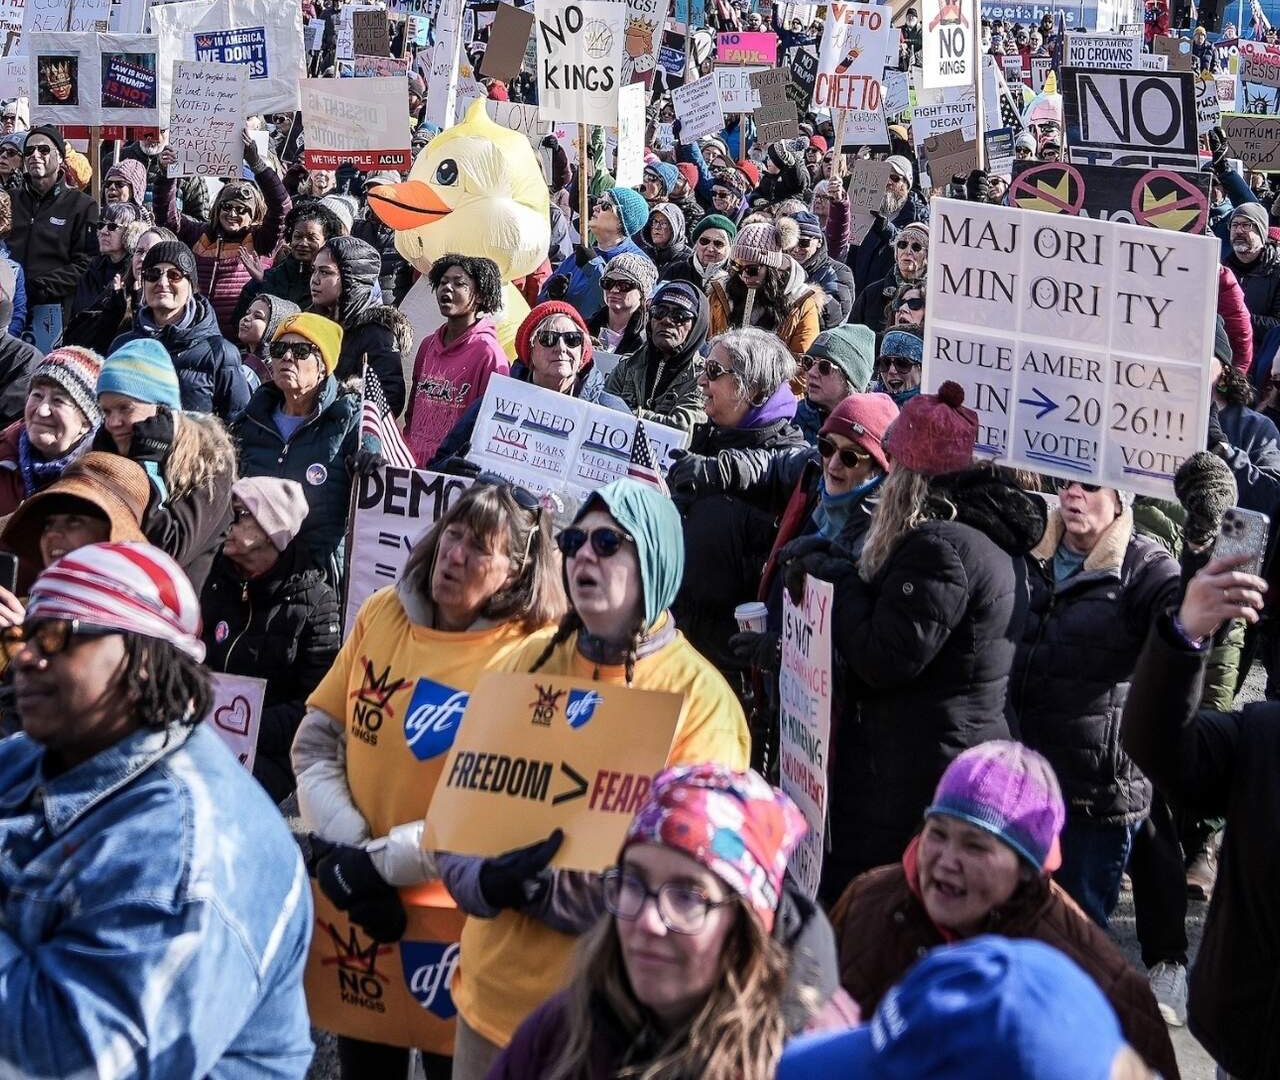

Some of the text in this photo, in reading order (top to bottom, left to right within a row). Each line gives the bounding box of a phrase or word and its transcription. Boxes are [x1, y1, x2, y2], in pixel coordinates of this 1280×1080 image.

[831, 3, 882, 30] VETO
[215, 32, 264, 45] IN AMERICA,
[540, 6, 583, 54] NO
[721, 35, 740, 45] NO
[940, 29, 965, 58] NO
[197, 45, 264, 61] WE DON'T
[802, 54, 814, 67] NO
[1071, 48, 1132, 61] NO CROWNS
[111, 63, 154, 82] LAW KING
[544, 60, 614, 91] KINGS
[794, 65, 814, 84] TRUMP
[939, 62, 965, 75] KINGS
[1244, 61, 1280, 79] RESIST
[116, 74, 145, 90] TRUMP
[815, 72, 881, 110] CHEETO
[122, 85, 152, 102] NOT
[176, 99, 210, 110] VOTED
[914, 102, 977, 118] FIGHT TRUTH
[1078, 73, 1183, 146] NO
[930, 117, 964, 128] DECAY
[177, 127, 233, 139] FASCIST
[1228, 128, 1280, 139] UNTRUMP
[178, 139, 234, 151] RAPIST
[186, 151, 230, 163] LYING
[338, 154, 404, 165] PEOPLE. ACLU
[1234, 153, 1273, 162] WORLD
[183, 163, 238, 176] LOSER
[934, 336, 1012, 371] RULE
[975, 383, 1009, 415] IN
[495, 397, 574, 433] WE NEED
[495, 425, 532, 446] NOT
[486, 442, 529, 463] LIARS,
[1024, 429, 1098, 462] VOTE!
[795, 617, 813, 657] NOT
[532, 705, 555, 719] NO
[566, 692, 604, 720] aft
[352, 701, 384, 732] NO
[406, 692, 467, 748] aft
[351, 725, 378, 746] KINGS
[446, 752, 650, 814] FREEDOM FEAR
[339, 972, 384, 1000] NO
[341, 993, 385, 1013] KINGS
